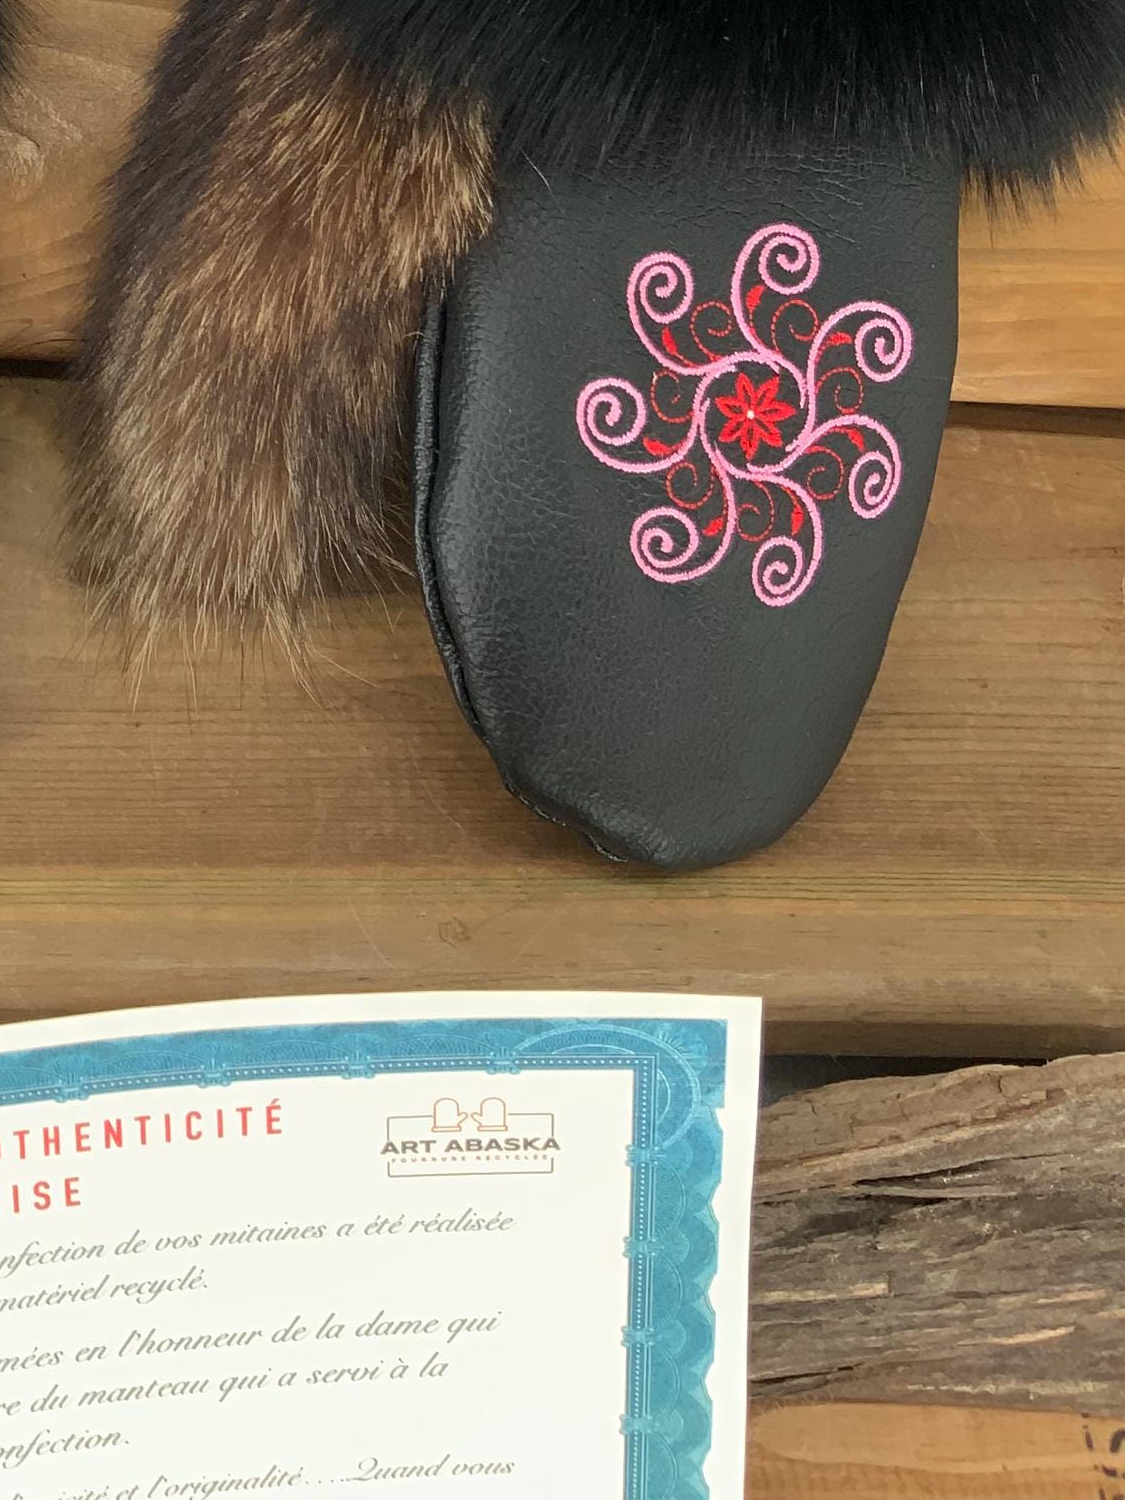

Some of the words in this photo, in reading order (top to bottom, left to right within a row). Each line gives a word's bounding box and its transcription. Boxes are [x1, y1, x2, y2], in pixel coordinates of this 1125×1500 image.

[381, 1140, 436, 1154] ART
[444, 1137, 560, 1152] ABASKA
[114, 1228, 146, 1256] de
[155, 1232, 202, 1251] vos
[210, 1221, 327, 1247] mitaines
[336, 1221, 354, 1237] a
[364, 1213, 405, 1236] été
[409, 1206, 514, 1234] réalisée
[110, 1265, 209, 1304] recyclé.
[75, 1344, 108, 1363] en
[118, 1327, 262, 1358] l'honneur
[271, 1315, 306, 1345] de
[315, 1312, 345, 1341] la
[355, 1310, 438, 1339] dame
[447, 1311, 501, 1344] qui
[30, 1384, 69, 1413] du
[77, 1377, 210, 1408] manteau
[218, 1368, 271, 1403] qui
[278, 1371, 297, 1388] a
[307, 1360, 383, 1385] servi
[390, 1357, 409, 1380] à
[419, 1351, 449, 1378] la
[451, 1460, 515, 1476] vous
